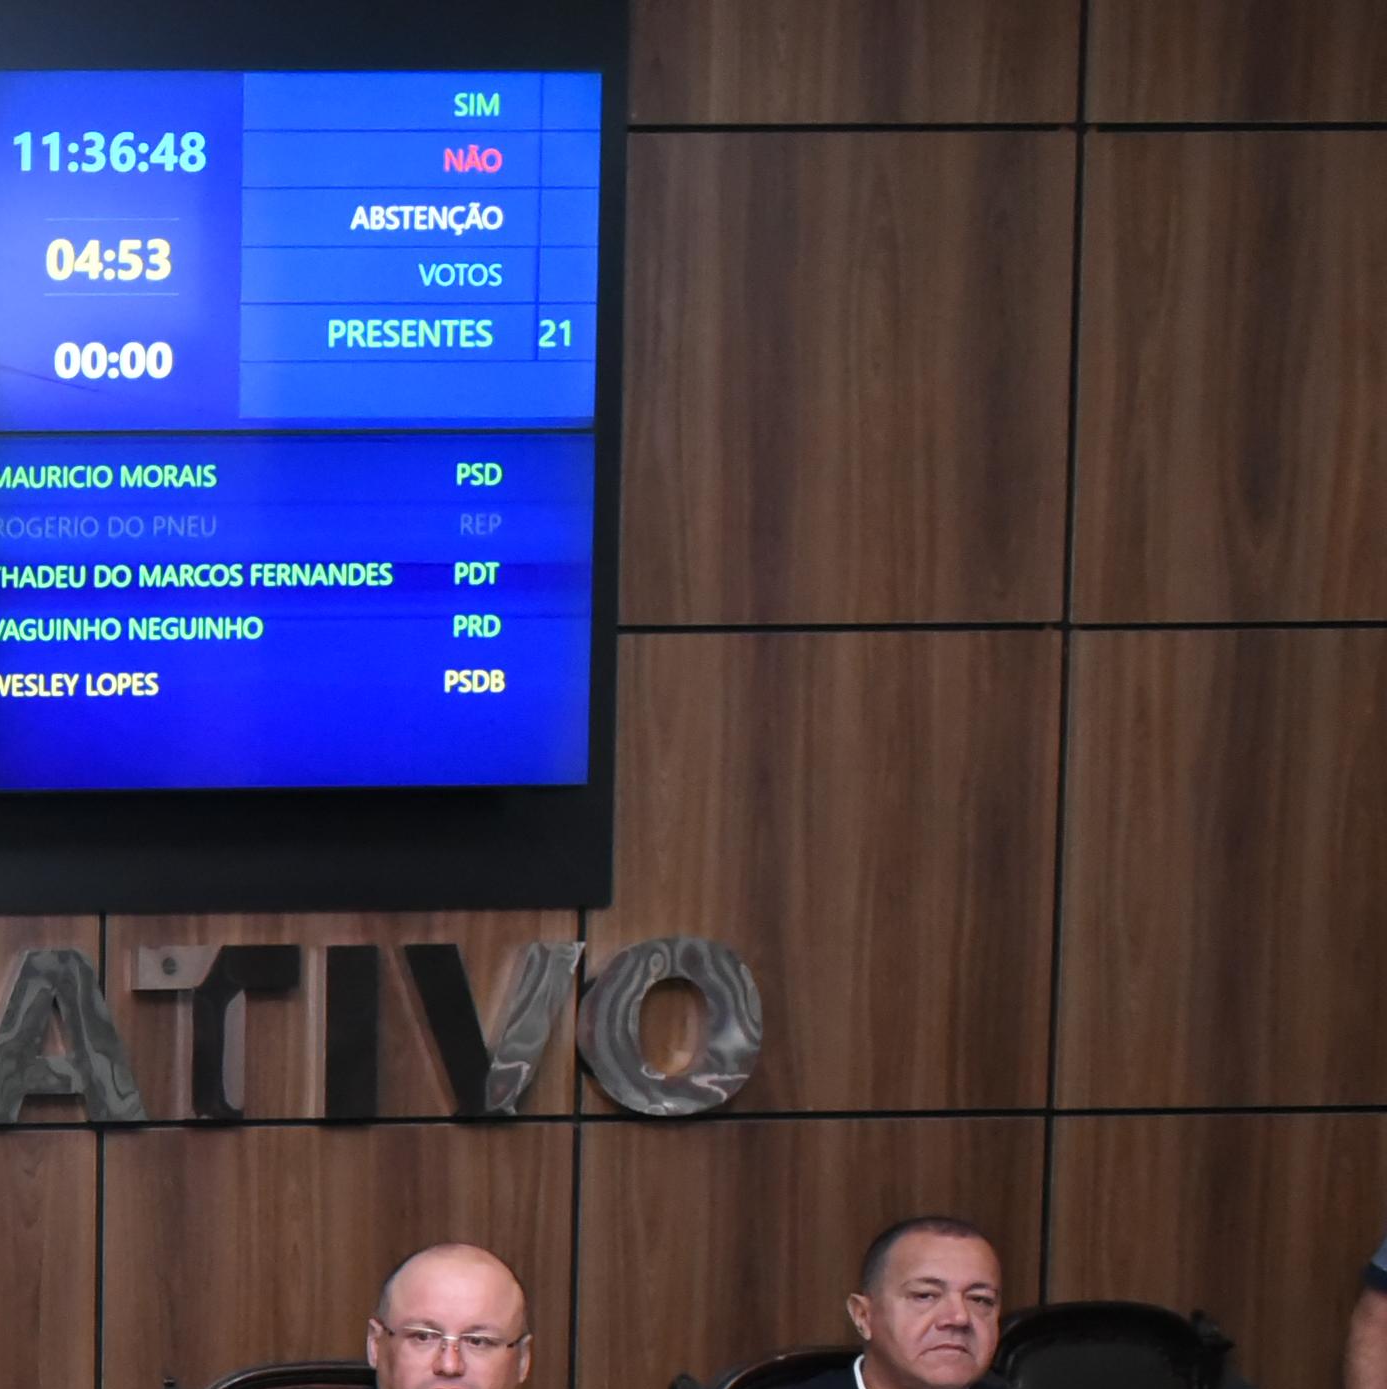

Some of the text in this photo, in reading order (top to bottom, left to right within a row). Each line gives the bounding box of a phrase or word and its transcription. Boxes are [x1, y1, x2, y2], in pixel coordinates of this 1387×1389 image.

[453, 92, 500, 117] SIM
[13, 131, 207, 173] 11:36:48
[443, 143, 503, 174] NÃO
[349, 202, 504, 235] ABSTENÇÃO
[45, 237, 172, 282] 04:53
[418, 263, 503, 287] VOTOS
[327, 318, 494, 349] PRESENTES
[539, 319, 572, 349] 21
[54, 341, 174, 380] 00:00
[120, 463, 218, 489] MORAIS
[456, 462, 503, 487] PSD
[107, 515, 145, 539] DO
[152, 514, 217, 538] PNEU
[459, 512, 503, 536] REP
[93, 564, 133, 589] DO
[138, 563, 244, 588] MARCOS
[250, 562, 394, 588] FERNANDES
[454, 561, 501, 586] PDT
[128, 615, 264, 641] NEGUINHO
[452, 613, 502, 639] PRD
[85, 672, 160, 697] LOPES
[443, 669, 506, 694] PSDB
